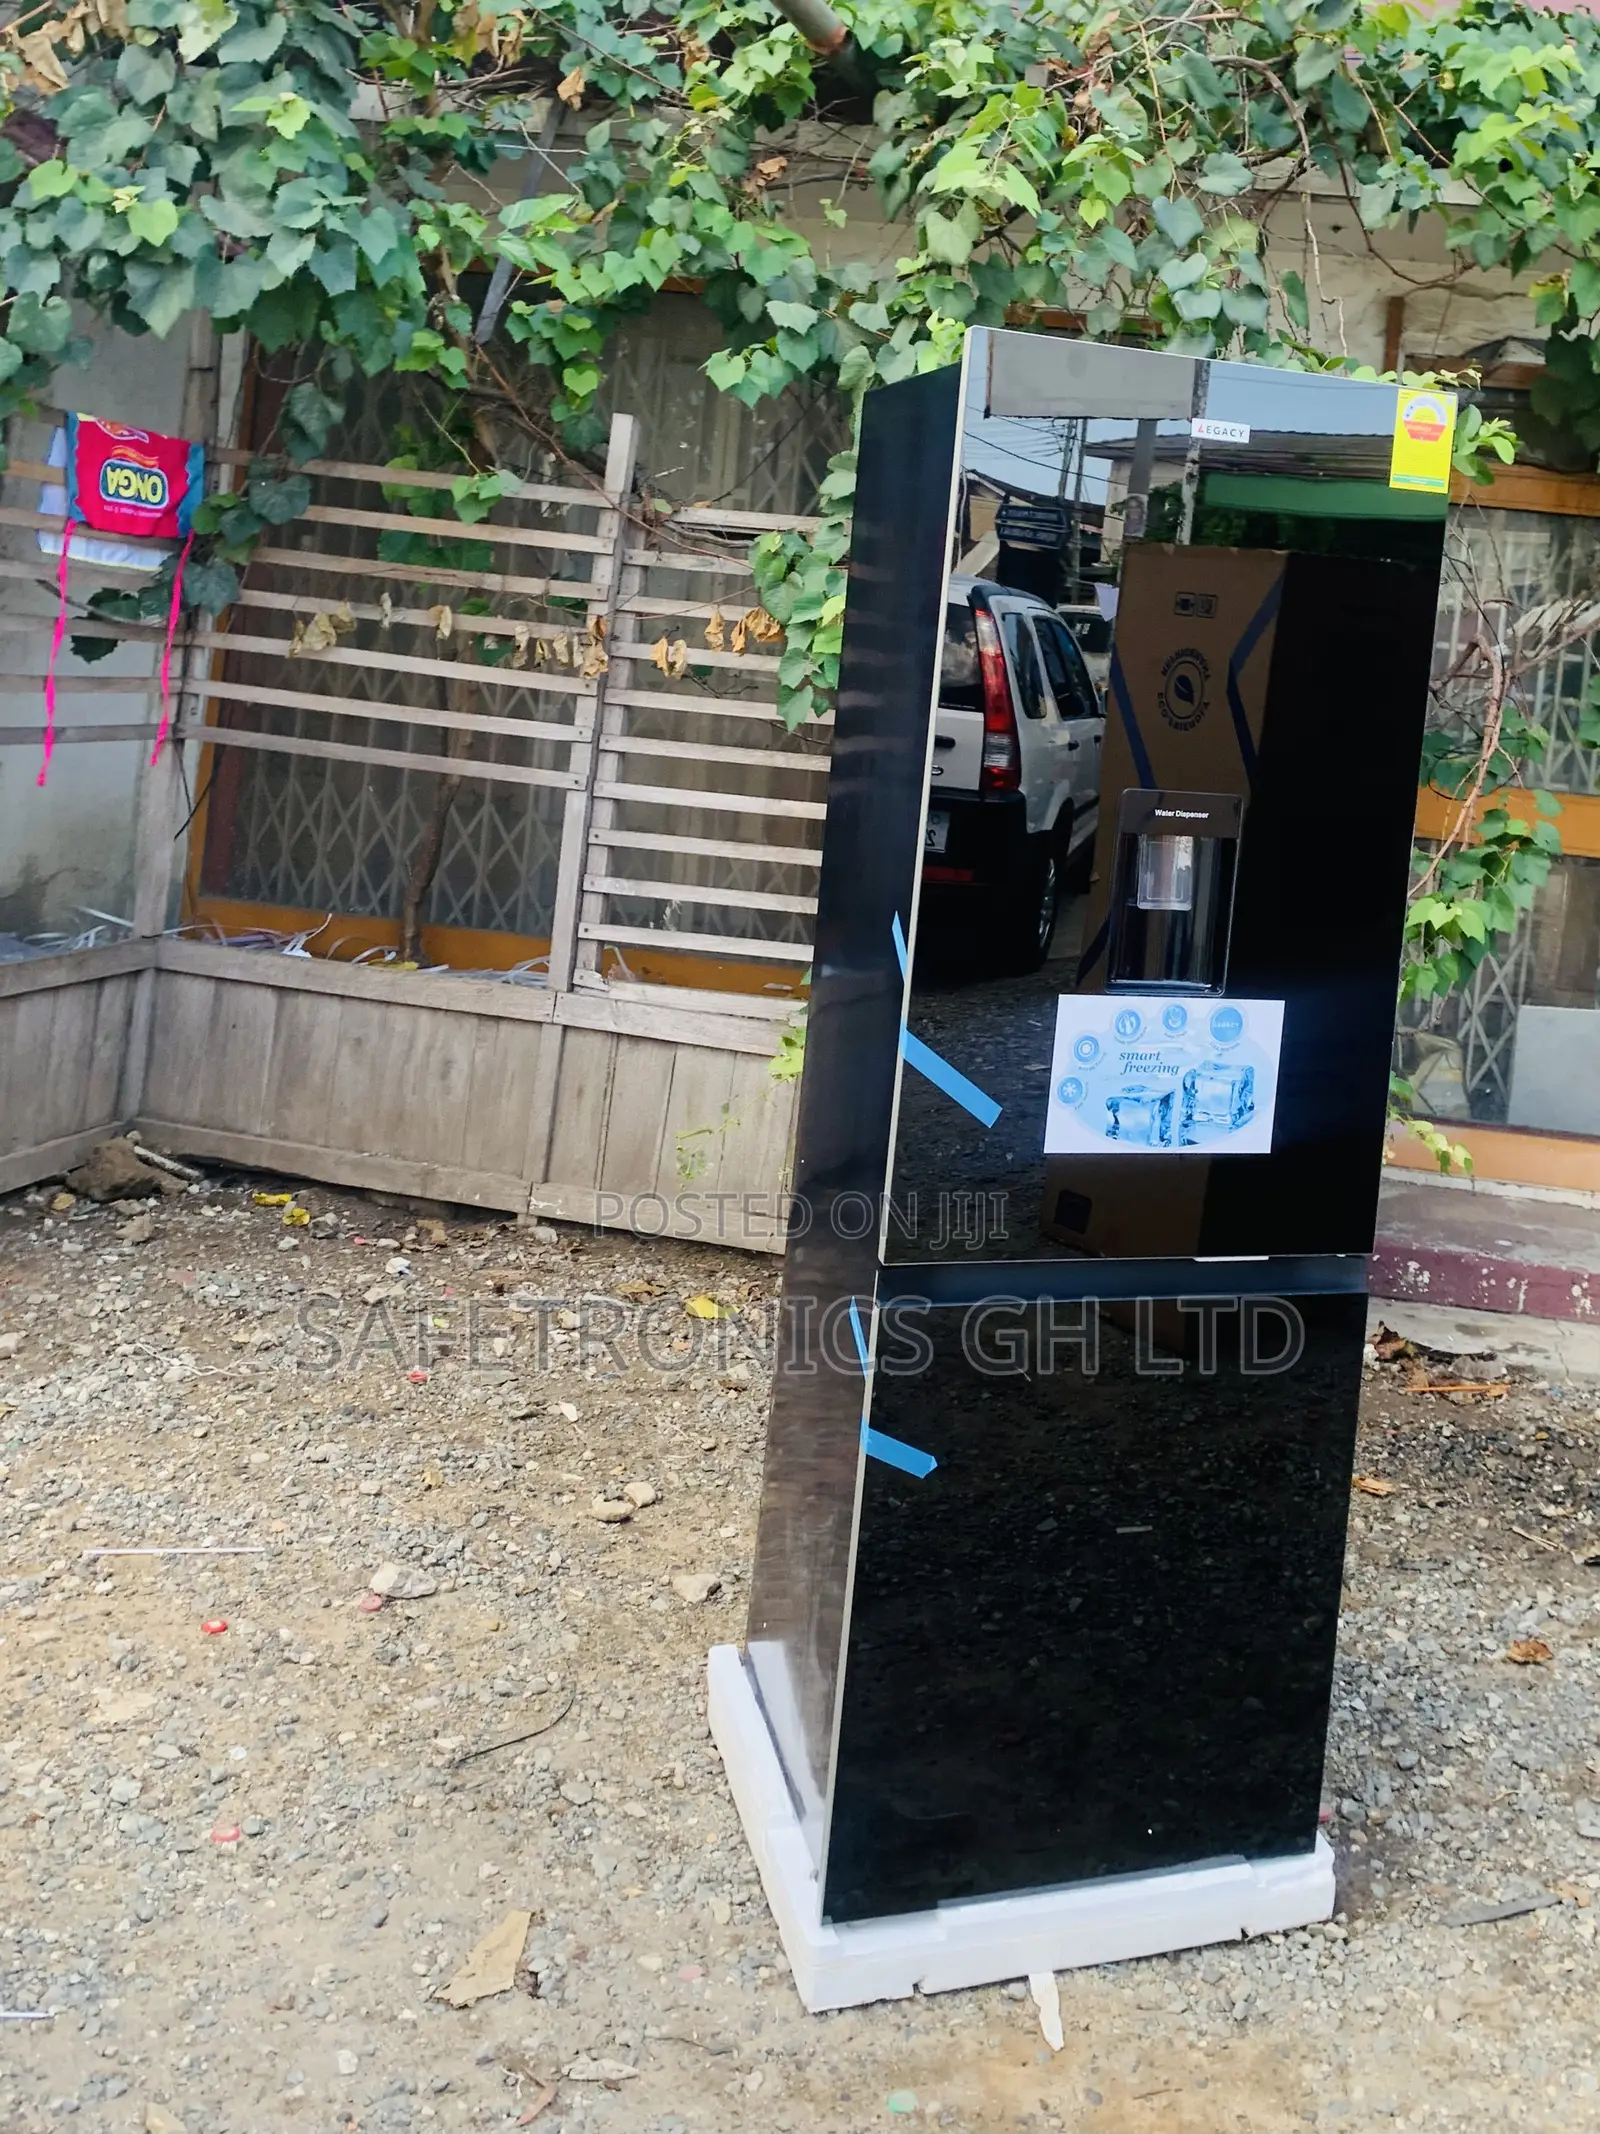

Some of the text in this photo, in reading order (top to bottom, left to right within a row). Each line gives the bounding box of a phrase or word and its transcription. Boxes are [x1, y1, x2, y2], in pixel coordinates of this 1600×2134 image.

[1197, 424, 1244, 438] LEGACY
[106, 466, 162, 503] ONGA
[1155, 809, 1209, 819] Water Dispenser
[1119, 1051, 1161, 1061] smart
[1120, 1061, 1180, 1076] freezing
